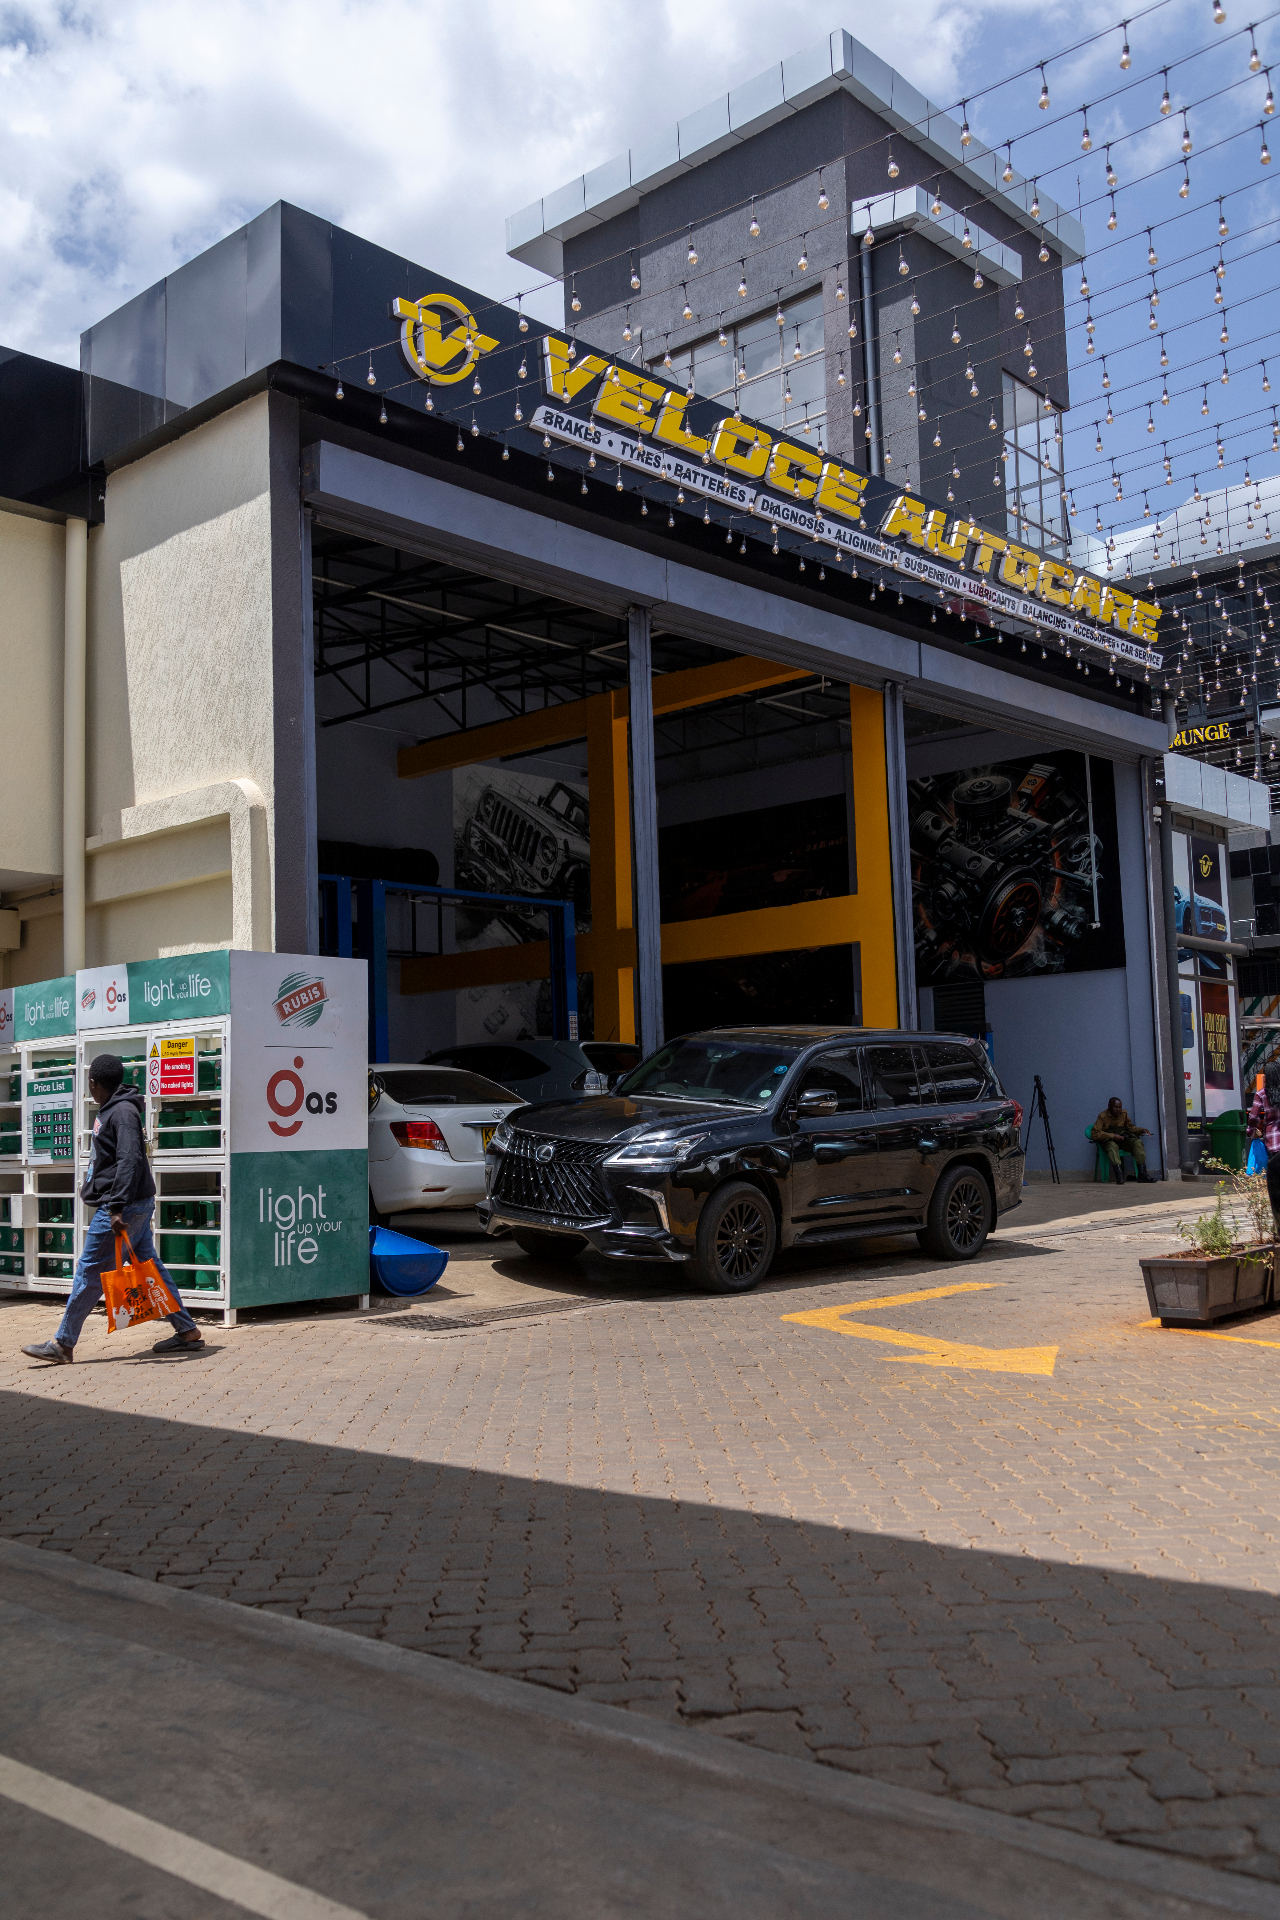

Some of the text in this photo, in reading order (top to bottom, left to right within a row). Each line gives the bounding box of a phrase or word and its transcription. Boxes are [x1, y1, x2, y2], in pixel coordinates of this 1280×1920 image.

[544, 335, 1163, 643] VELOCE AUTOCARE
[543, 410, 1161, 666] BRAKES TYRES BATTERIES DIAGNOSIS ALIGNMENT SUSPENSION LUBRICANTS BALANCING ACCESSORIES CAR SERVICE
[1168, 722, 1231, 749] OUNGE
[144, 978, 175, 1007] light
[188, 973, 212, 997] life
[25, 1000, 46, 1026] light
[54, 996, 70, 1018] life
[167, 1041, 189, 1049] Danger
[1216, 1034, 1228, 1053] YOUR
[164, 1063, 191, 1071] No smoking
[1211, 1053, 1226, 1073] TYRES
[33, 1081, 66, 1093] Price List
[168, 1081, 180, 1089] naked
[180, 1081, 194, 1090] lights
[266, 1055, 338, 1138] gas
[259, 1184, 327, 1231] light
[297, 1220, 343, 1237] up your
[274, 1230, 319, 1267] life
